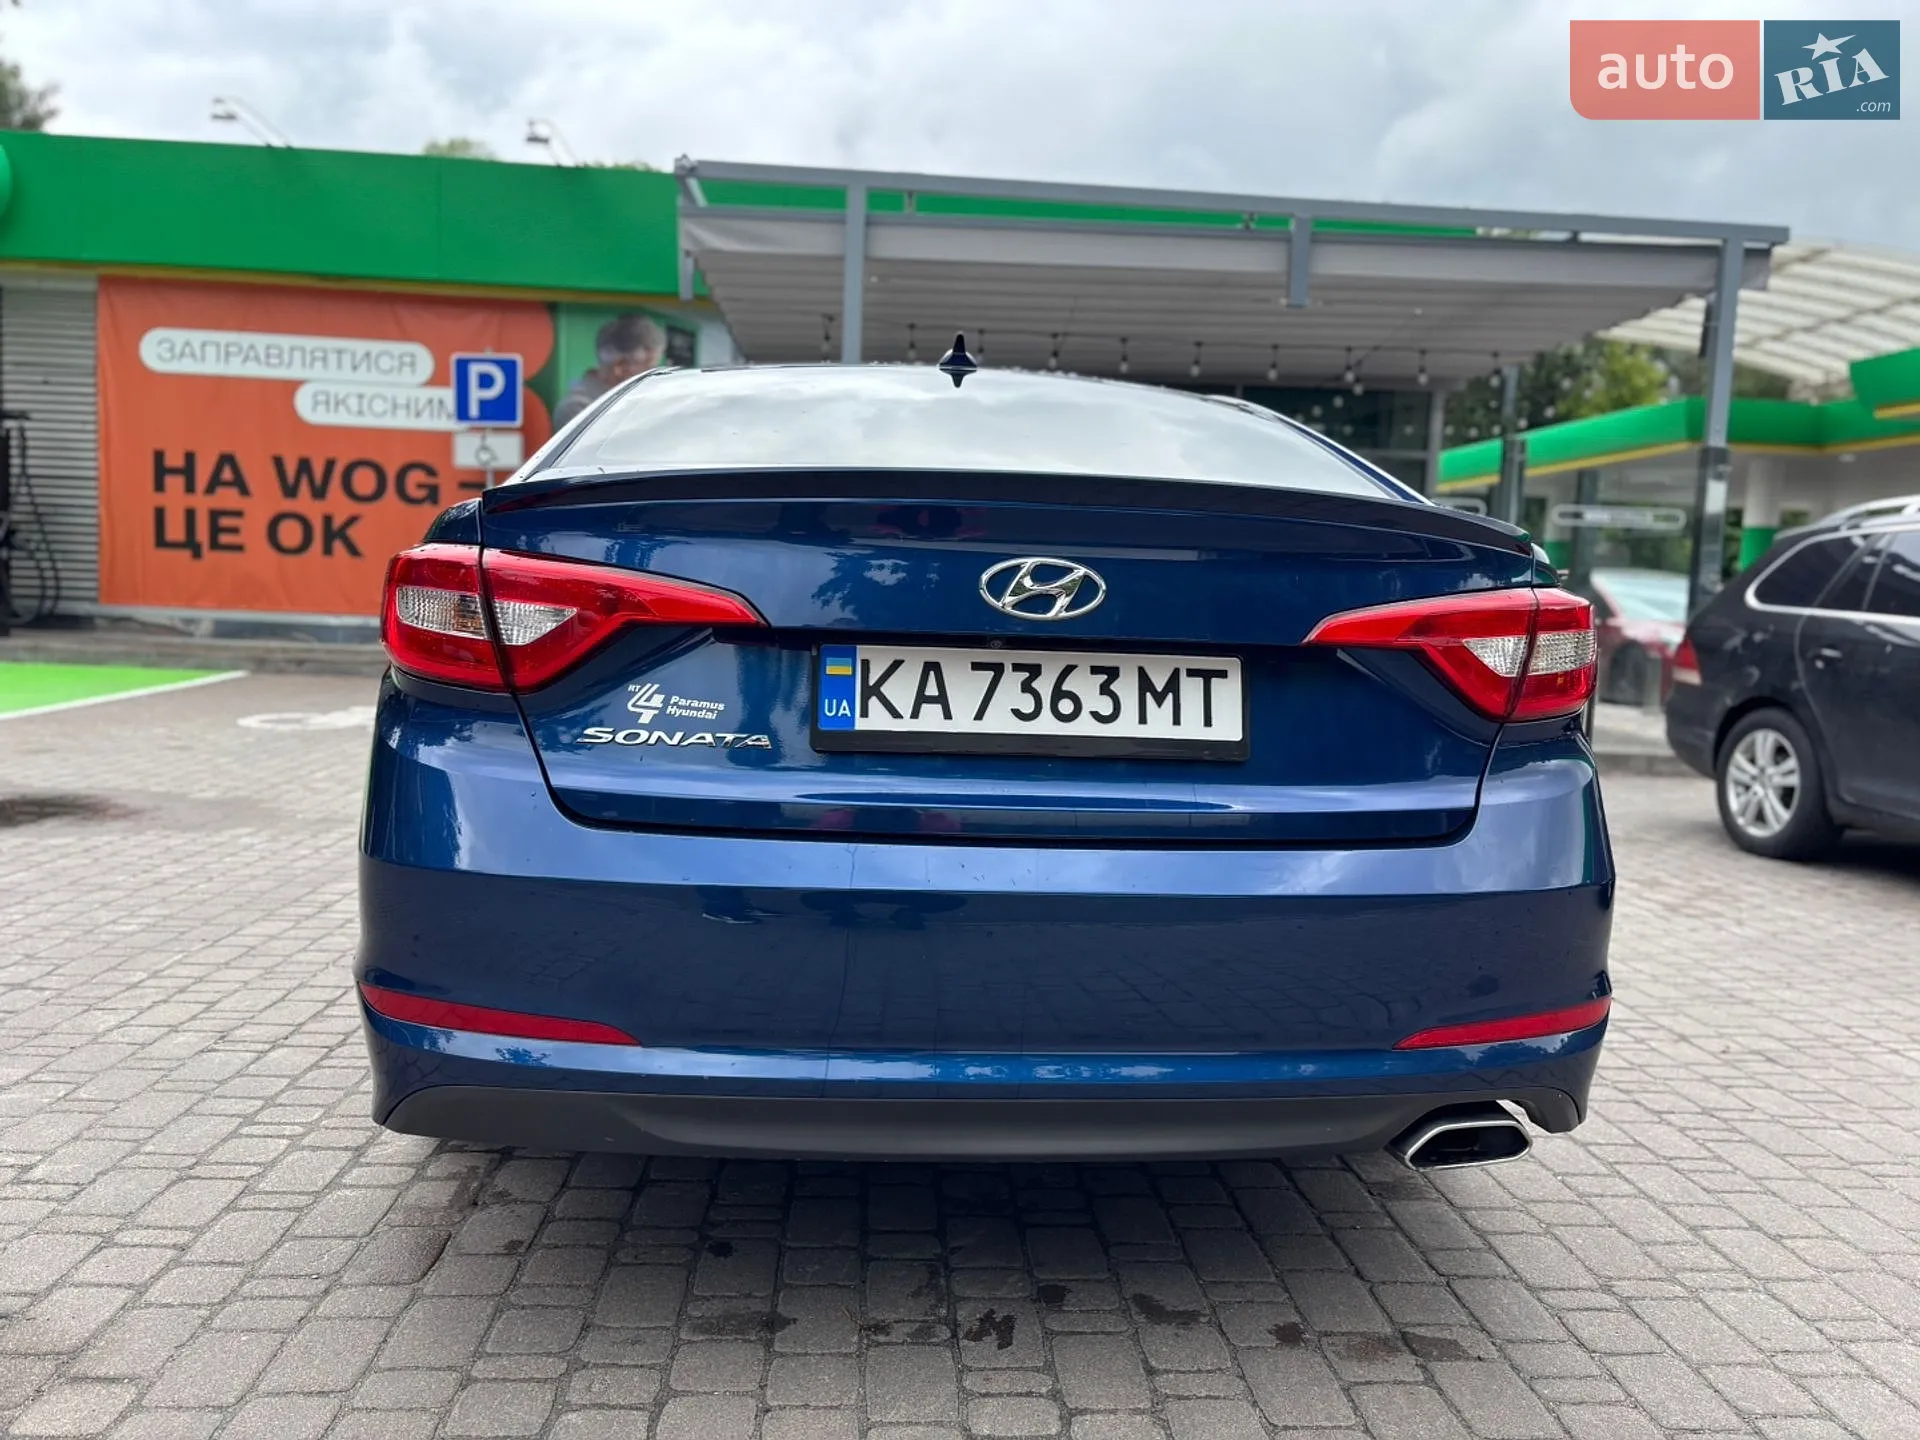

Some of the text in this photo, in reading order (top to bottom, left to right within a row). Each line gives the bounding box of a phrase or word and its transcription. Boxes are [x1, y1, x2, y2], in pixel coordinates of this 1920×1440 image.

[155, 336, 418, 376] ЗАПРАВЛЯТИСЯ
[467, 360, 506, 420] P
[152, 448, 251, 497] НА
[272, 454, 441, 506] WOG
[153, 505, 364, 559] ЦЕ ОК
[665, 705, 719, 720] Hyundai
[669, 695, 726, 711] Paramus
[824, 699, 851, 718] UA
[859, 658, 1228, 728] KA 7363 MT
[576, 727, 772, 750] SONATA
